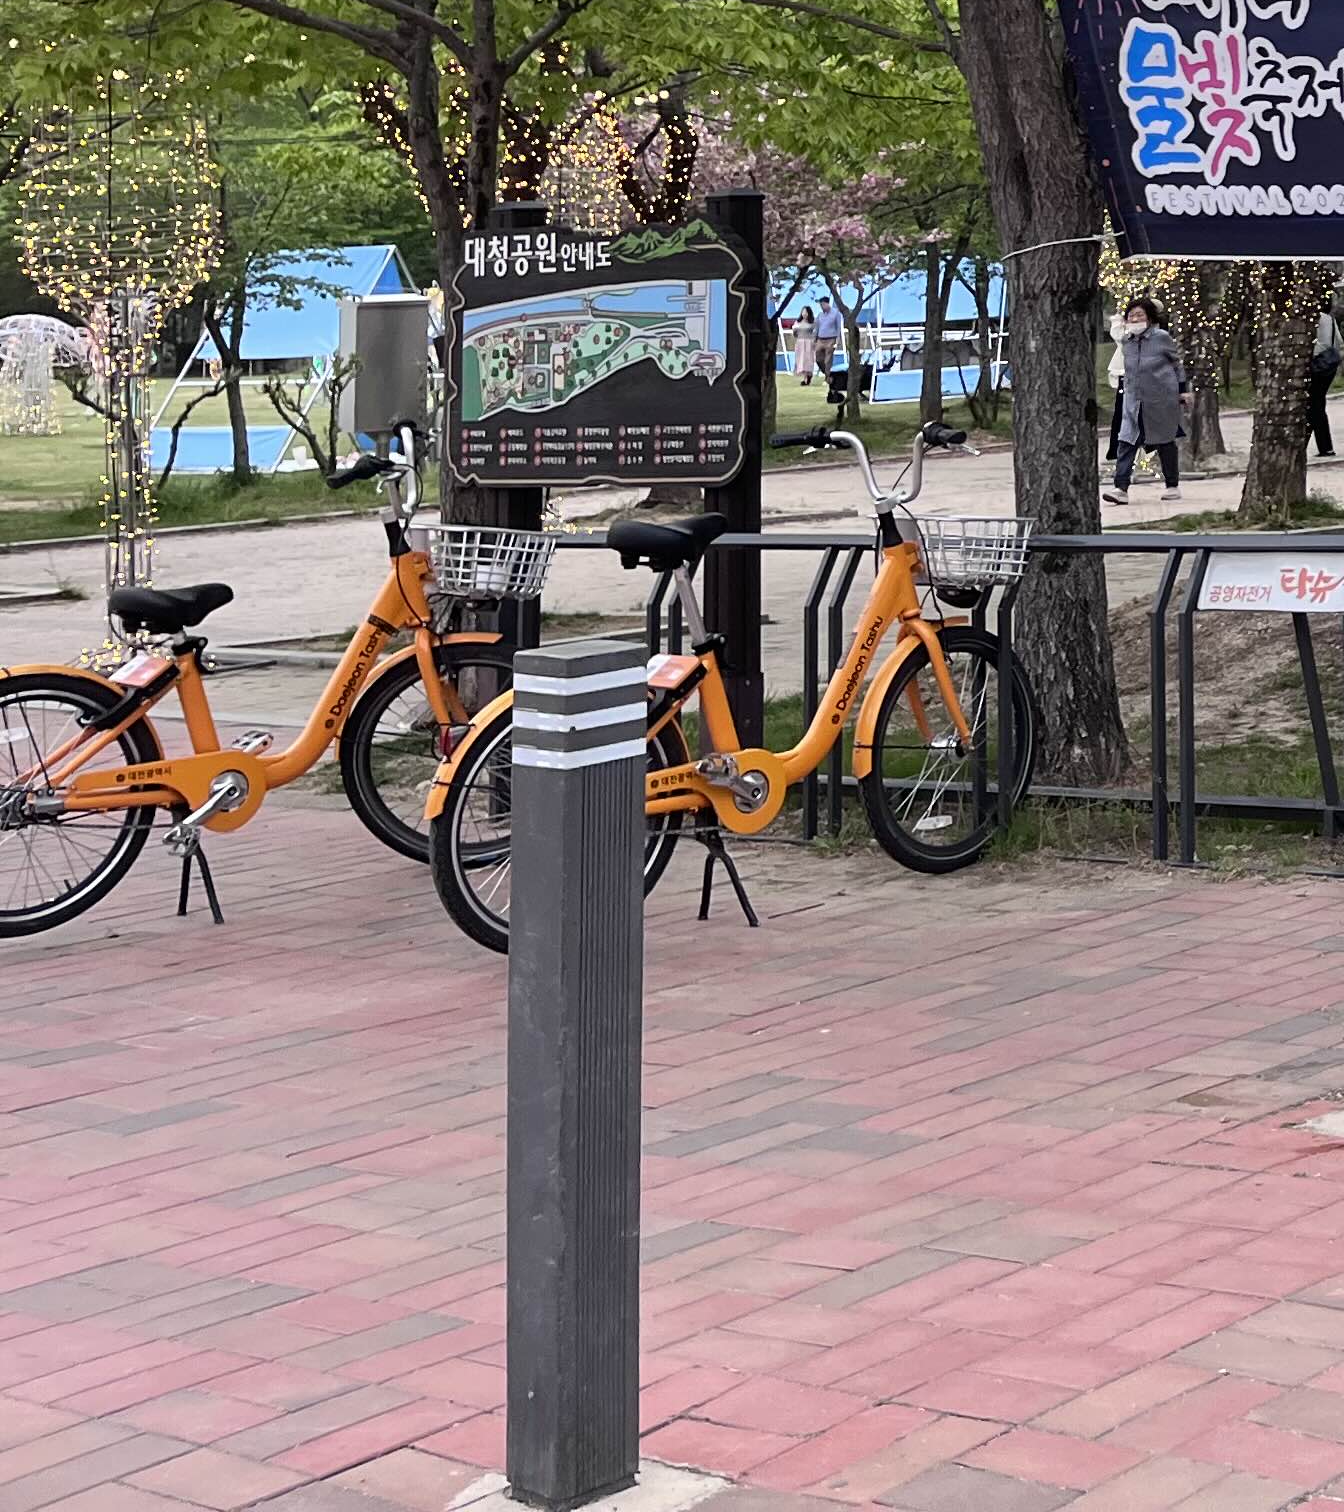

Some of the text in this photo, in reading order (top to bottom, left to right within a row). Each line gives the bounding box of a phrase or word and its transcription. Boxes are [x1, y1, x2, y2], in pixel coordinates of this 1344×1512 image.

[1150, 190, 1291, 210] FESTIVAL
[464, 232, 613, 278] 대청공원 안내도
[1209, 584, 1273, 603] 공영자전거
[835, 615, 884, 712] Daejeon Tashu
[329, 661, 366, 717] Daejeon
